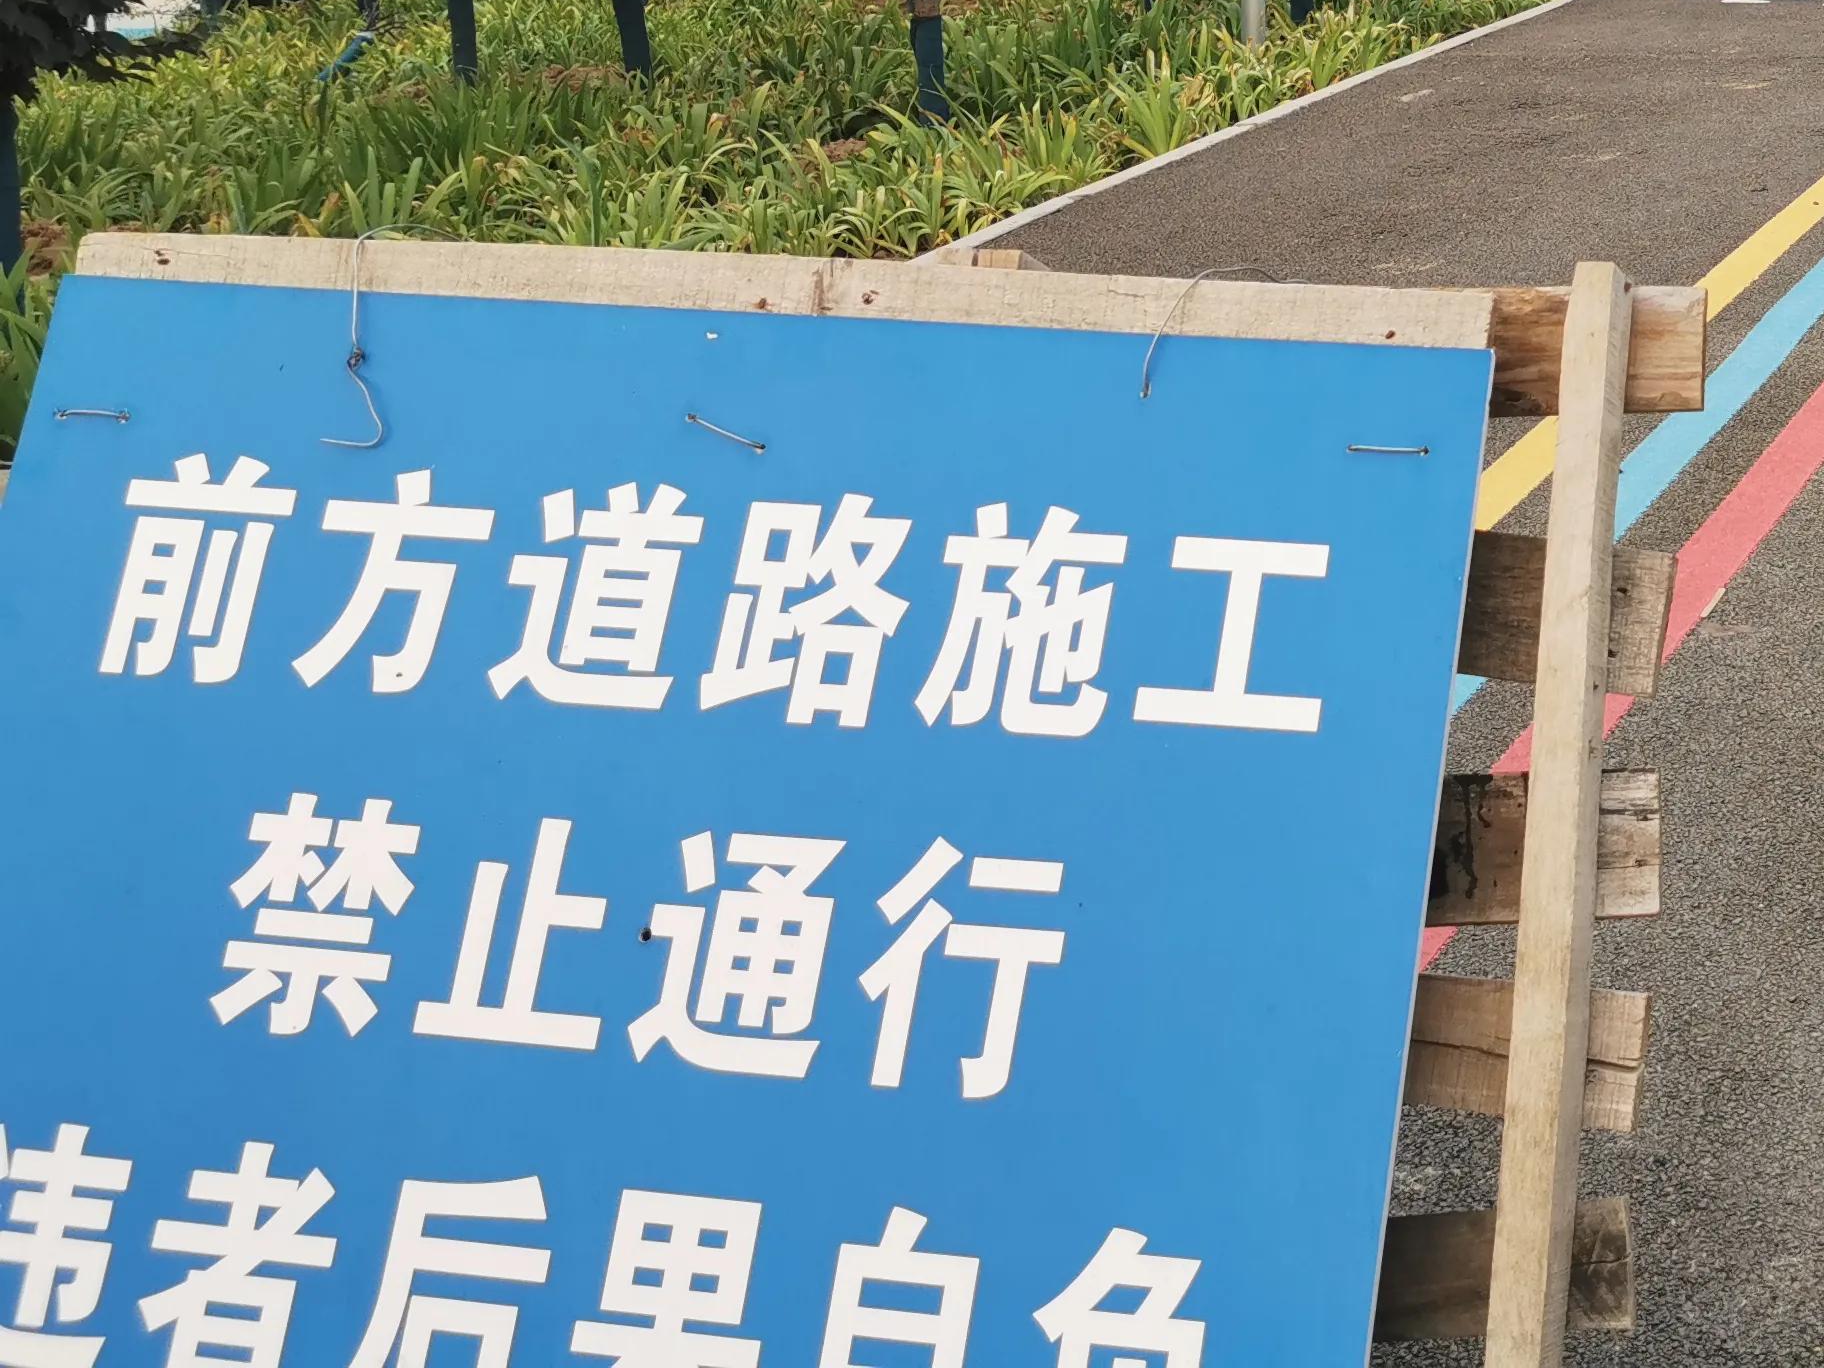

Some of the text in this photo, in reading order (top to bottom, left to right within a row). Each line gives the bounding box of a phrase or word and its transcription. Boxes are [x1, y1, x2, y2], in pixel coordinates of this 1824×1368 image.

[100, 452, 1332, 738] 前方道路施工
[209, 792, 1067, 1101] 禁止通行
